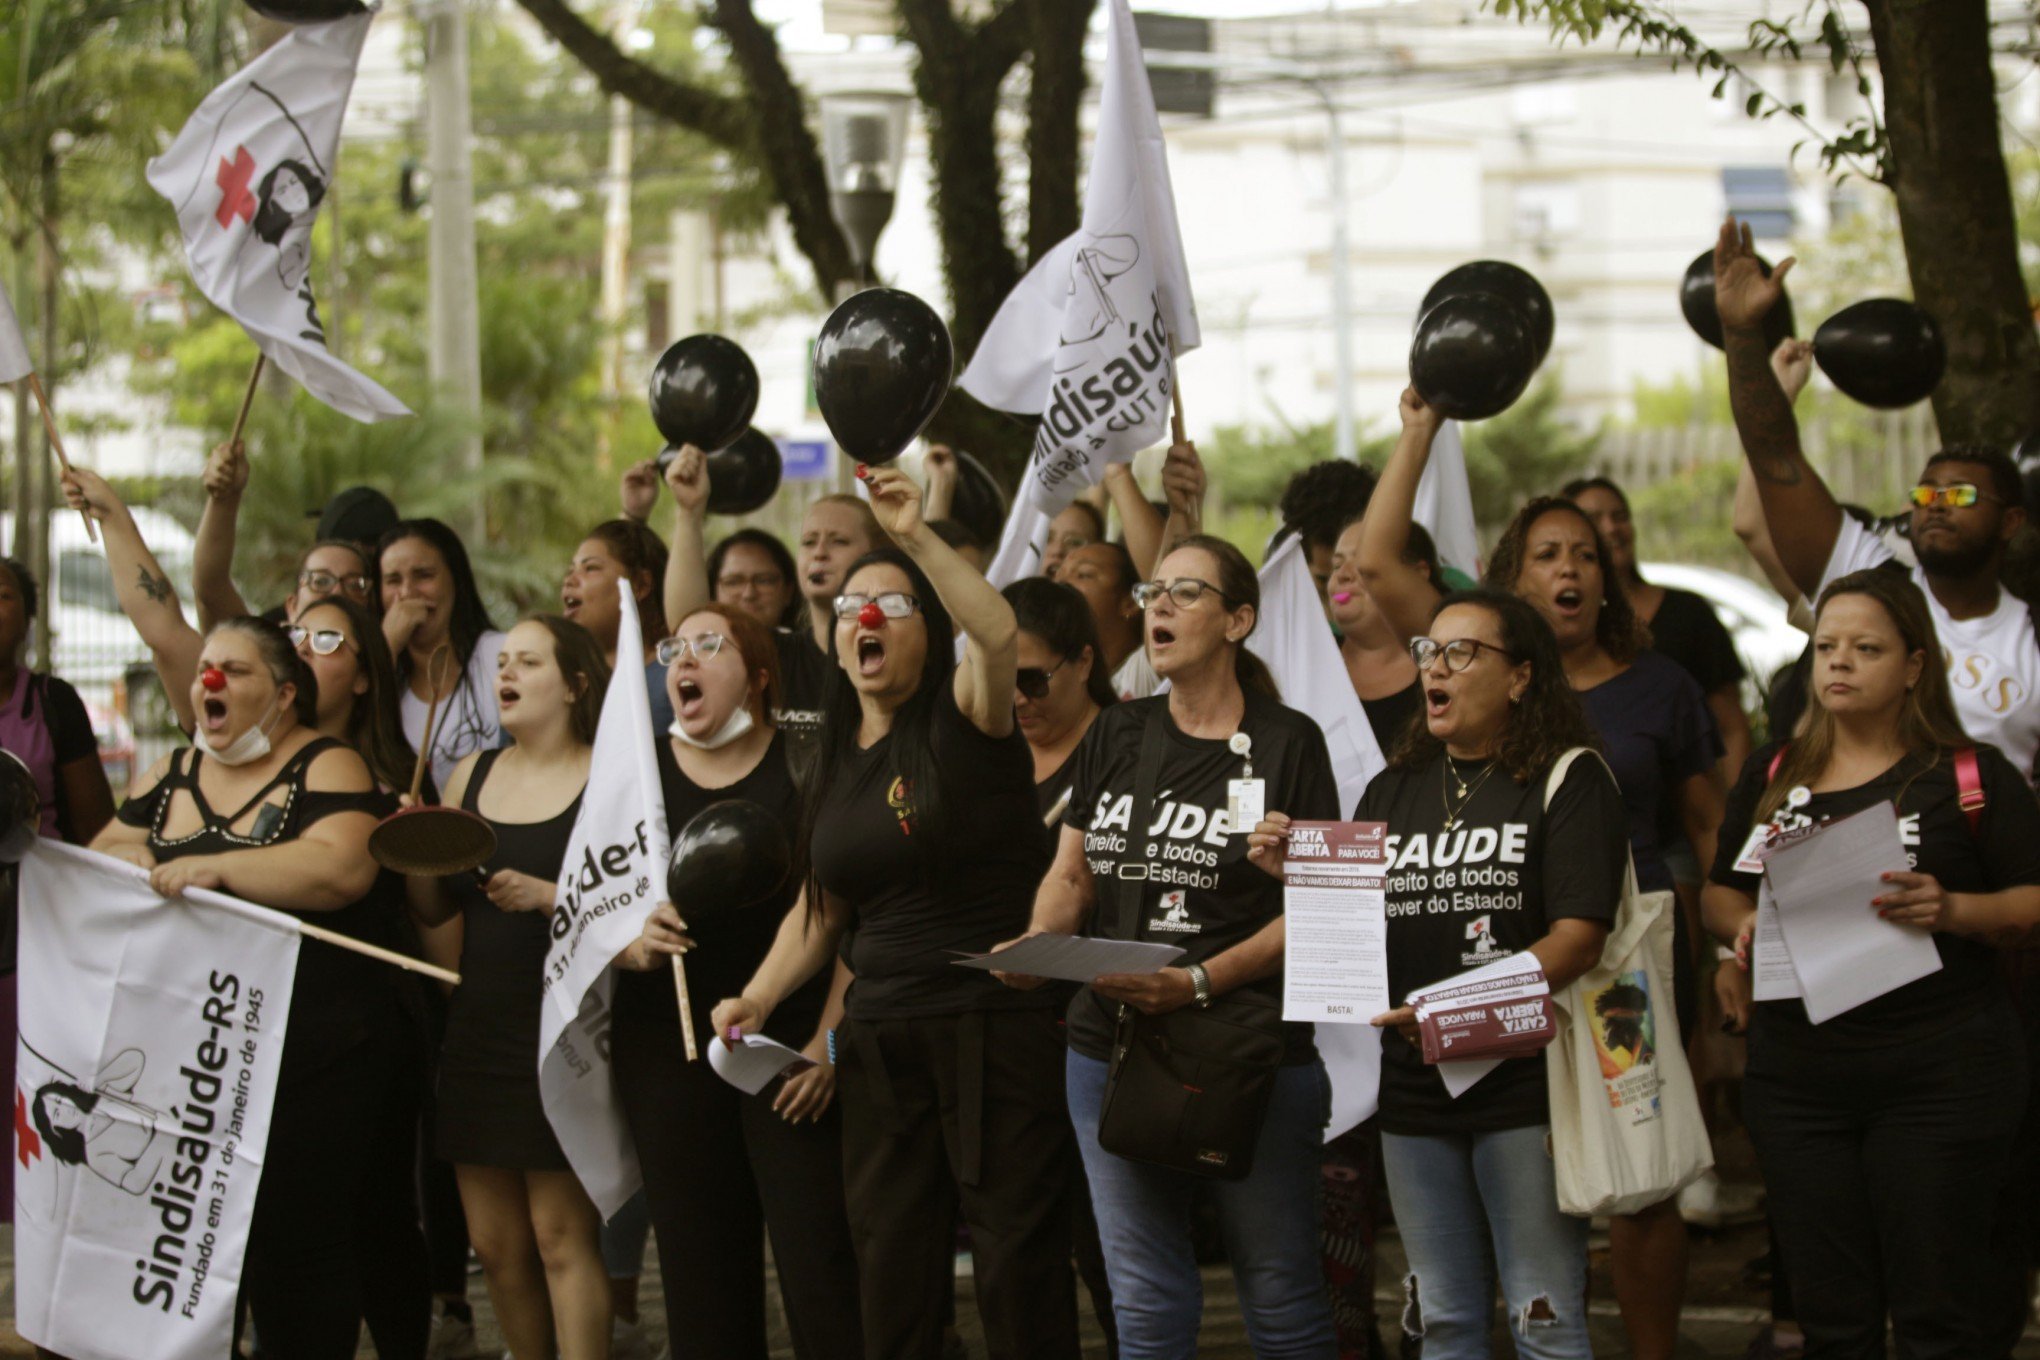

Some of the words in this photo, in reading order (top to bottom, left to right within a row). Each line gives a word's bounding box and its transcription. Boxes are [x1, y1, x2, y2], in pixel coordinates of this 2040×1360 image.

[1106, 387, 1157, 432] CUT
[1090, 789, 1231, 848] SAÚDE
[1146, 842, 1158, 858] e
[1163, 841, 1218, 867] todos
[1288, 843, 1330, 857] ABERTA
[1338, 848, 1358, 858] PARA
[1385, 819, 1528, 872] SAÚDE
[1087, 857, 1115, 876] ever
[1149, 862, 1219, 890] Estado!
[1293, 874, 1306, 885] NÃO
[1306, 876, 1328, 886] VAMOS
[1328, 877, 1351, 887] DEIXAR
[1385, 872, 1428, 894] ireito
[1434, 869, 1456, 890] de
[1461, 865, 1519, 887] todos
[1385, 900, 1422, 918] ever
[1427, 895, 1449, 914] do
[1453, 891, 1523, 911] Estado!
[553, 955, 569, 981] 31
[636, 874, 650, 898] de
[1487, 978, 1517, 989] VAMOS
[244, 988, 264, 1034] 1945
[1327, 1006, 1354, 1015] BASTA!
[1465, 1009, 1487, 1021] PARA
[1493, 1001, 1544, 1021] ABERTA
[1503, 1015, 1548, 1033] CARTA
[238, 1040, 257, 1066] de
[227, 1068, 252, 1142] janeiro
[133, 969, 240, 1313] Sindisaúde-RS
[222, 1140, 235, 1167] de
[212, 1170, 230, 1194] 31
[208, 1196, 223, 1229] em
[181, 1232, 215, 1320] Fundado
